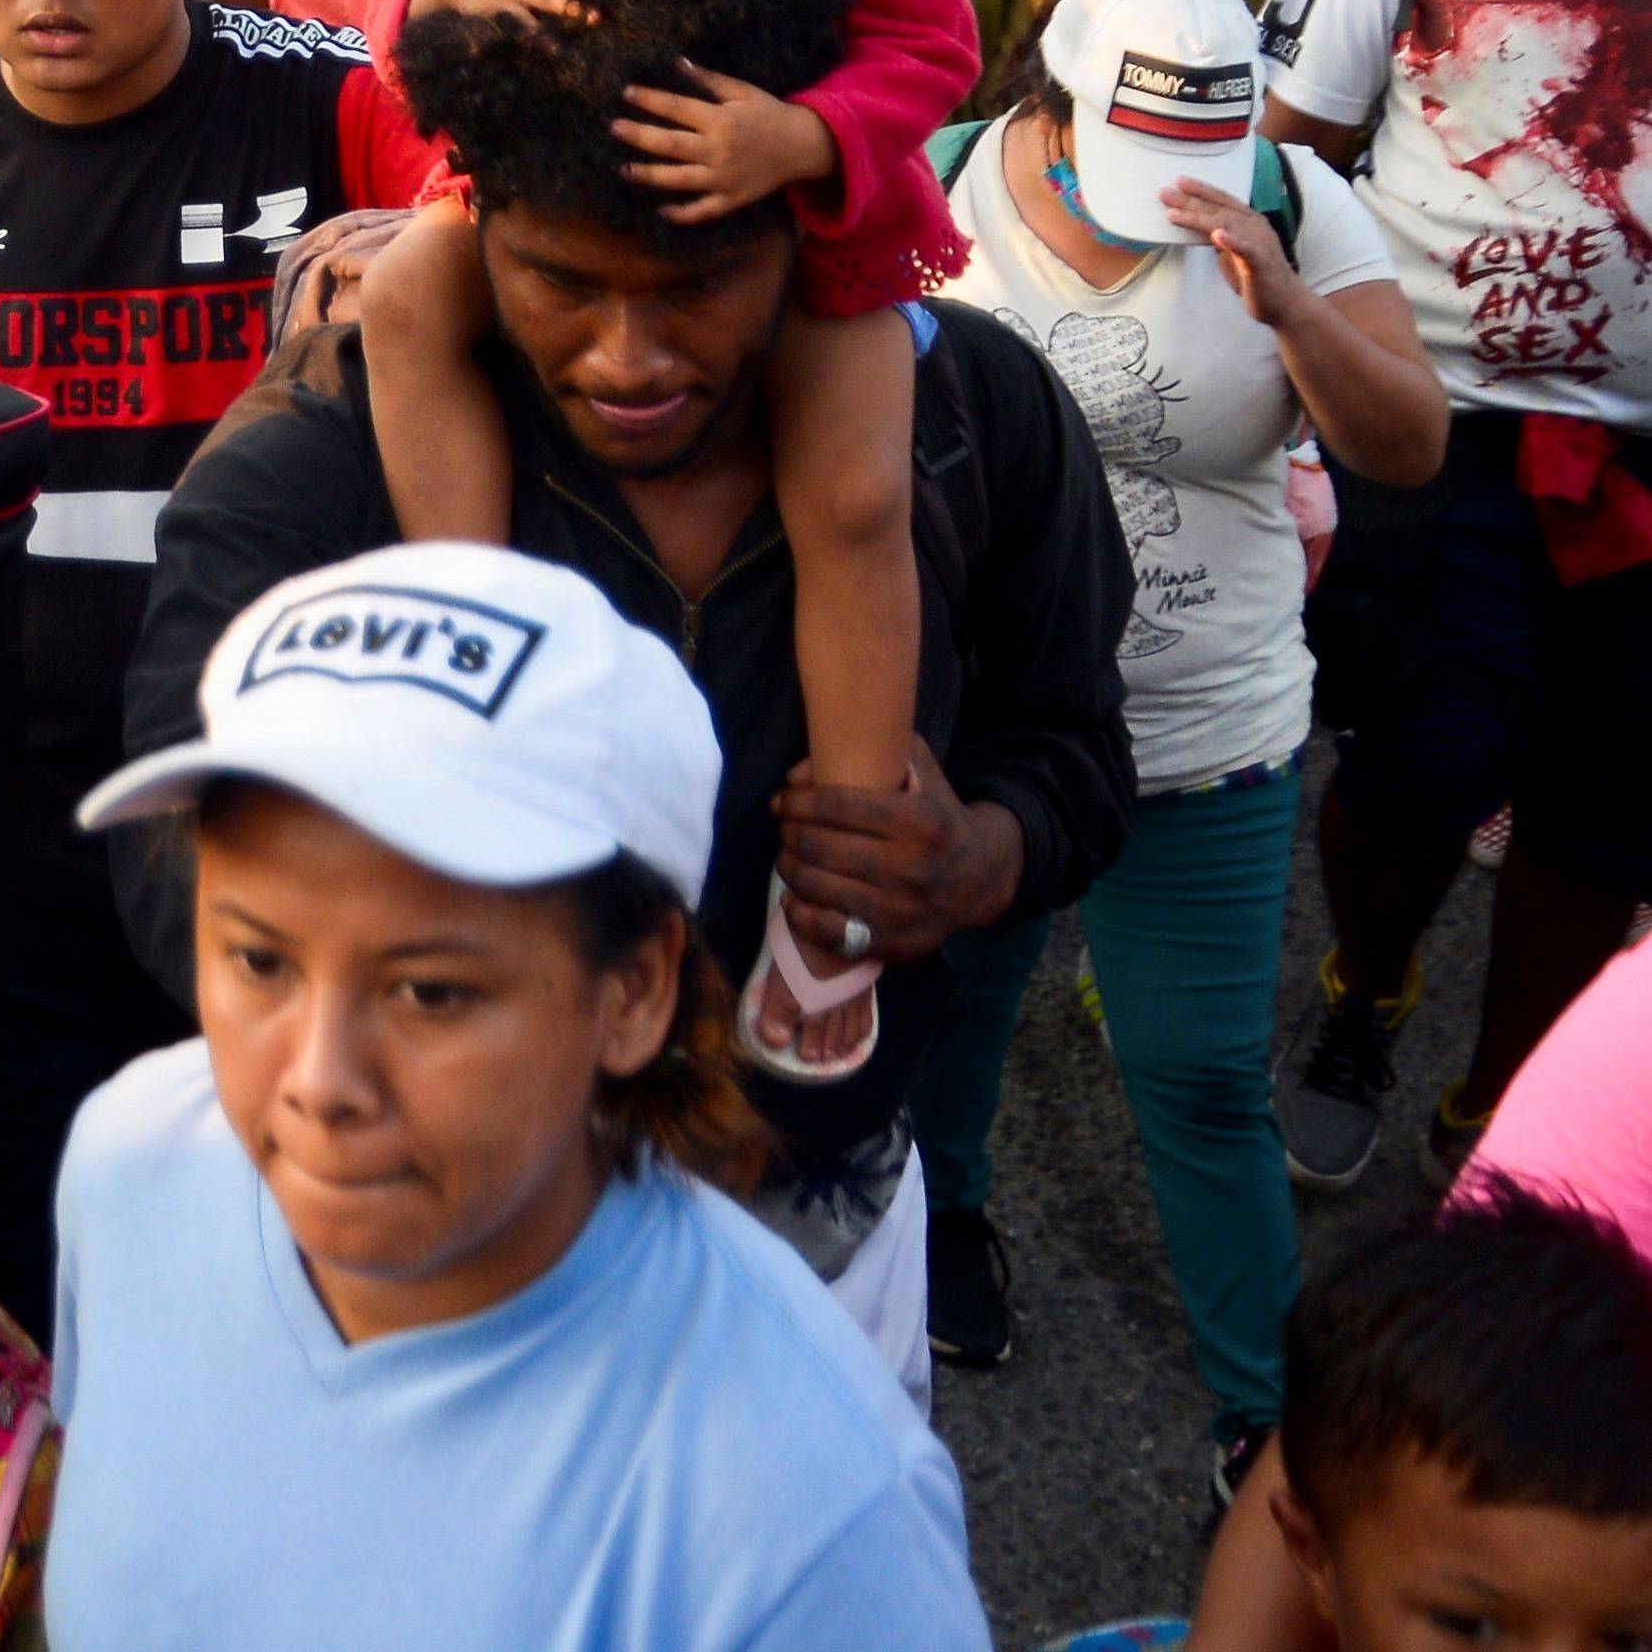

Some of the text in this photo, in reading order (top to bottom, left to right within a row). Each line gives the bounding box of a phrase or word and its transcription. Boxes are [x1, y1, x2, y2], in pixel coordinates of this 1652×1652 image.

[1121, 63, 1185, 97] TOMMY
[1455, 226, 1611, 289] LOVE
[1471, 273, 1593, 321] AND
[1470, 304, 1613, 364] SEX
[52, 378, 144, 417] 1994
[1140, 564, 1208, 589] Minnie
